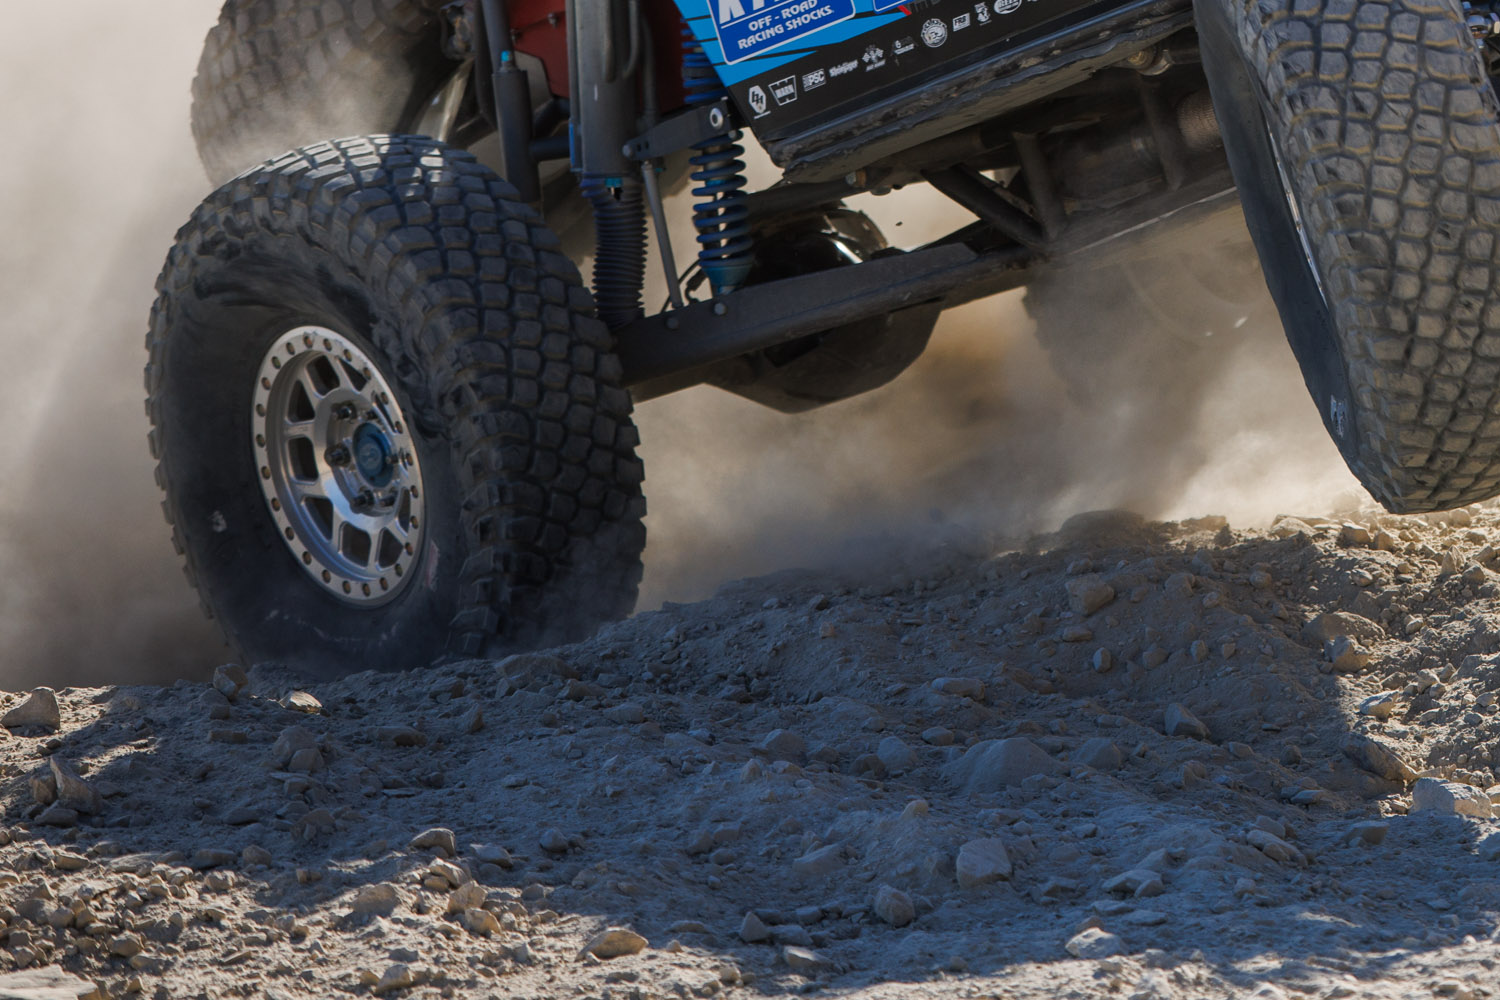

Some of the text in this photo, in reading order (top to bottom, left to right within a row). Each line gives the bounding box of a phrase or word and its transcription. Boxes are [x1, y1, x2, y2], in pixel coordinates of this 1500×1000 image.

[737, 5, 833, 50] RACING SHOCKS
[807, 70, 825, 87] PSC
